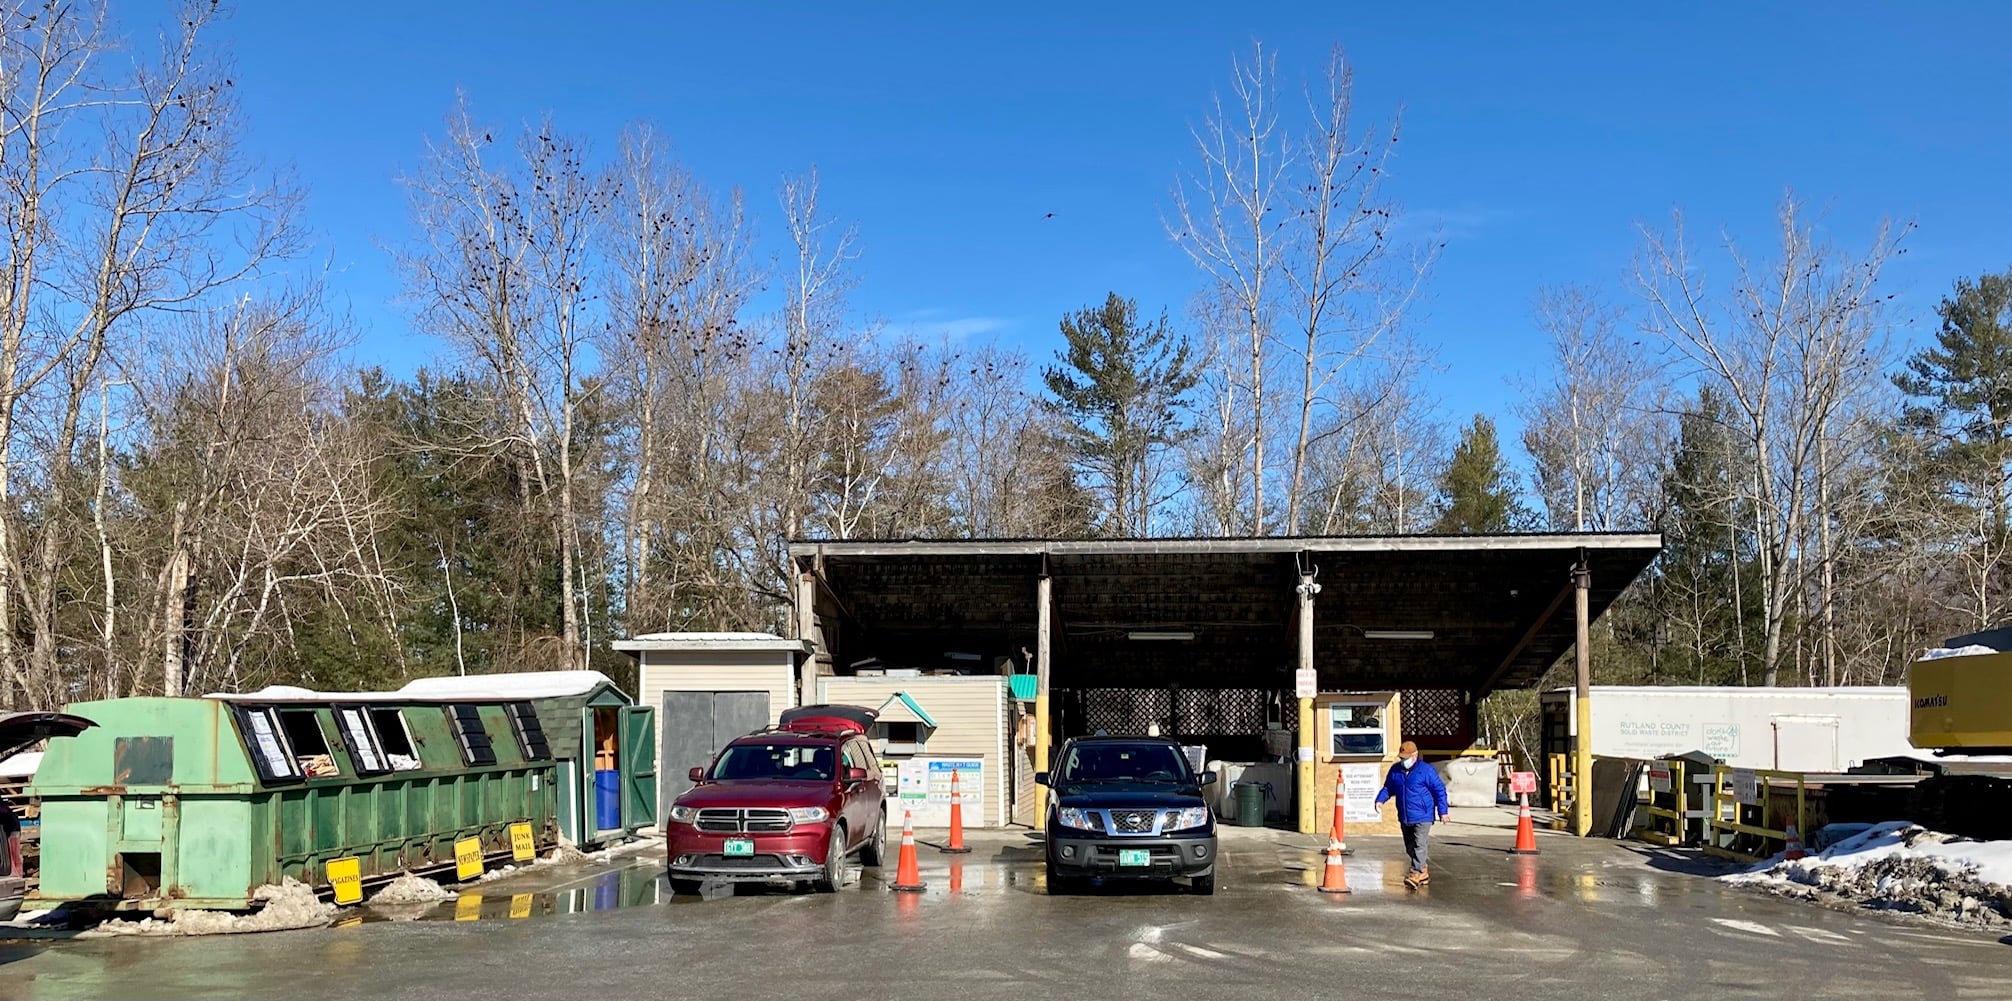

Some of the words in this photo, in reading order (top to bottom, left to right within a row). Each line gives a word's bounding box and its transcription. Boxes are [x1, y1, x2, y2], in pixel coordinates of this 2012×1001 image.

[1914, 694, 1948, 709] KOMATSU
[1620, 722, 1656, 730] RUTLAND
[1660, 722, 1690, 730] COUNTY
[514, 832, 531, 842] JUNK
[515, 843, 532, 852] MAIL
